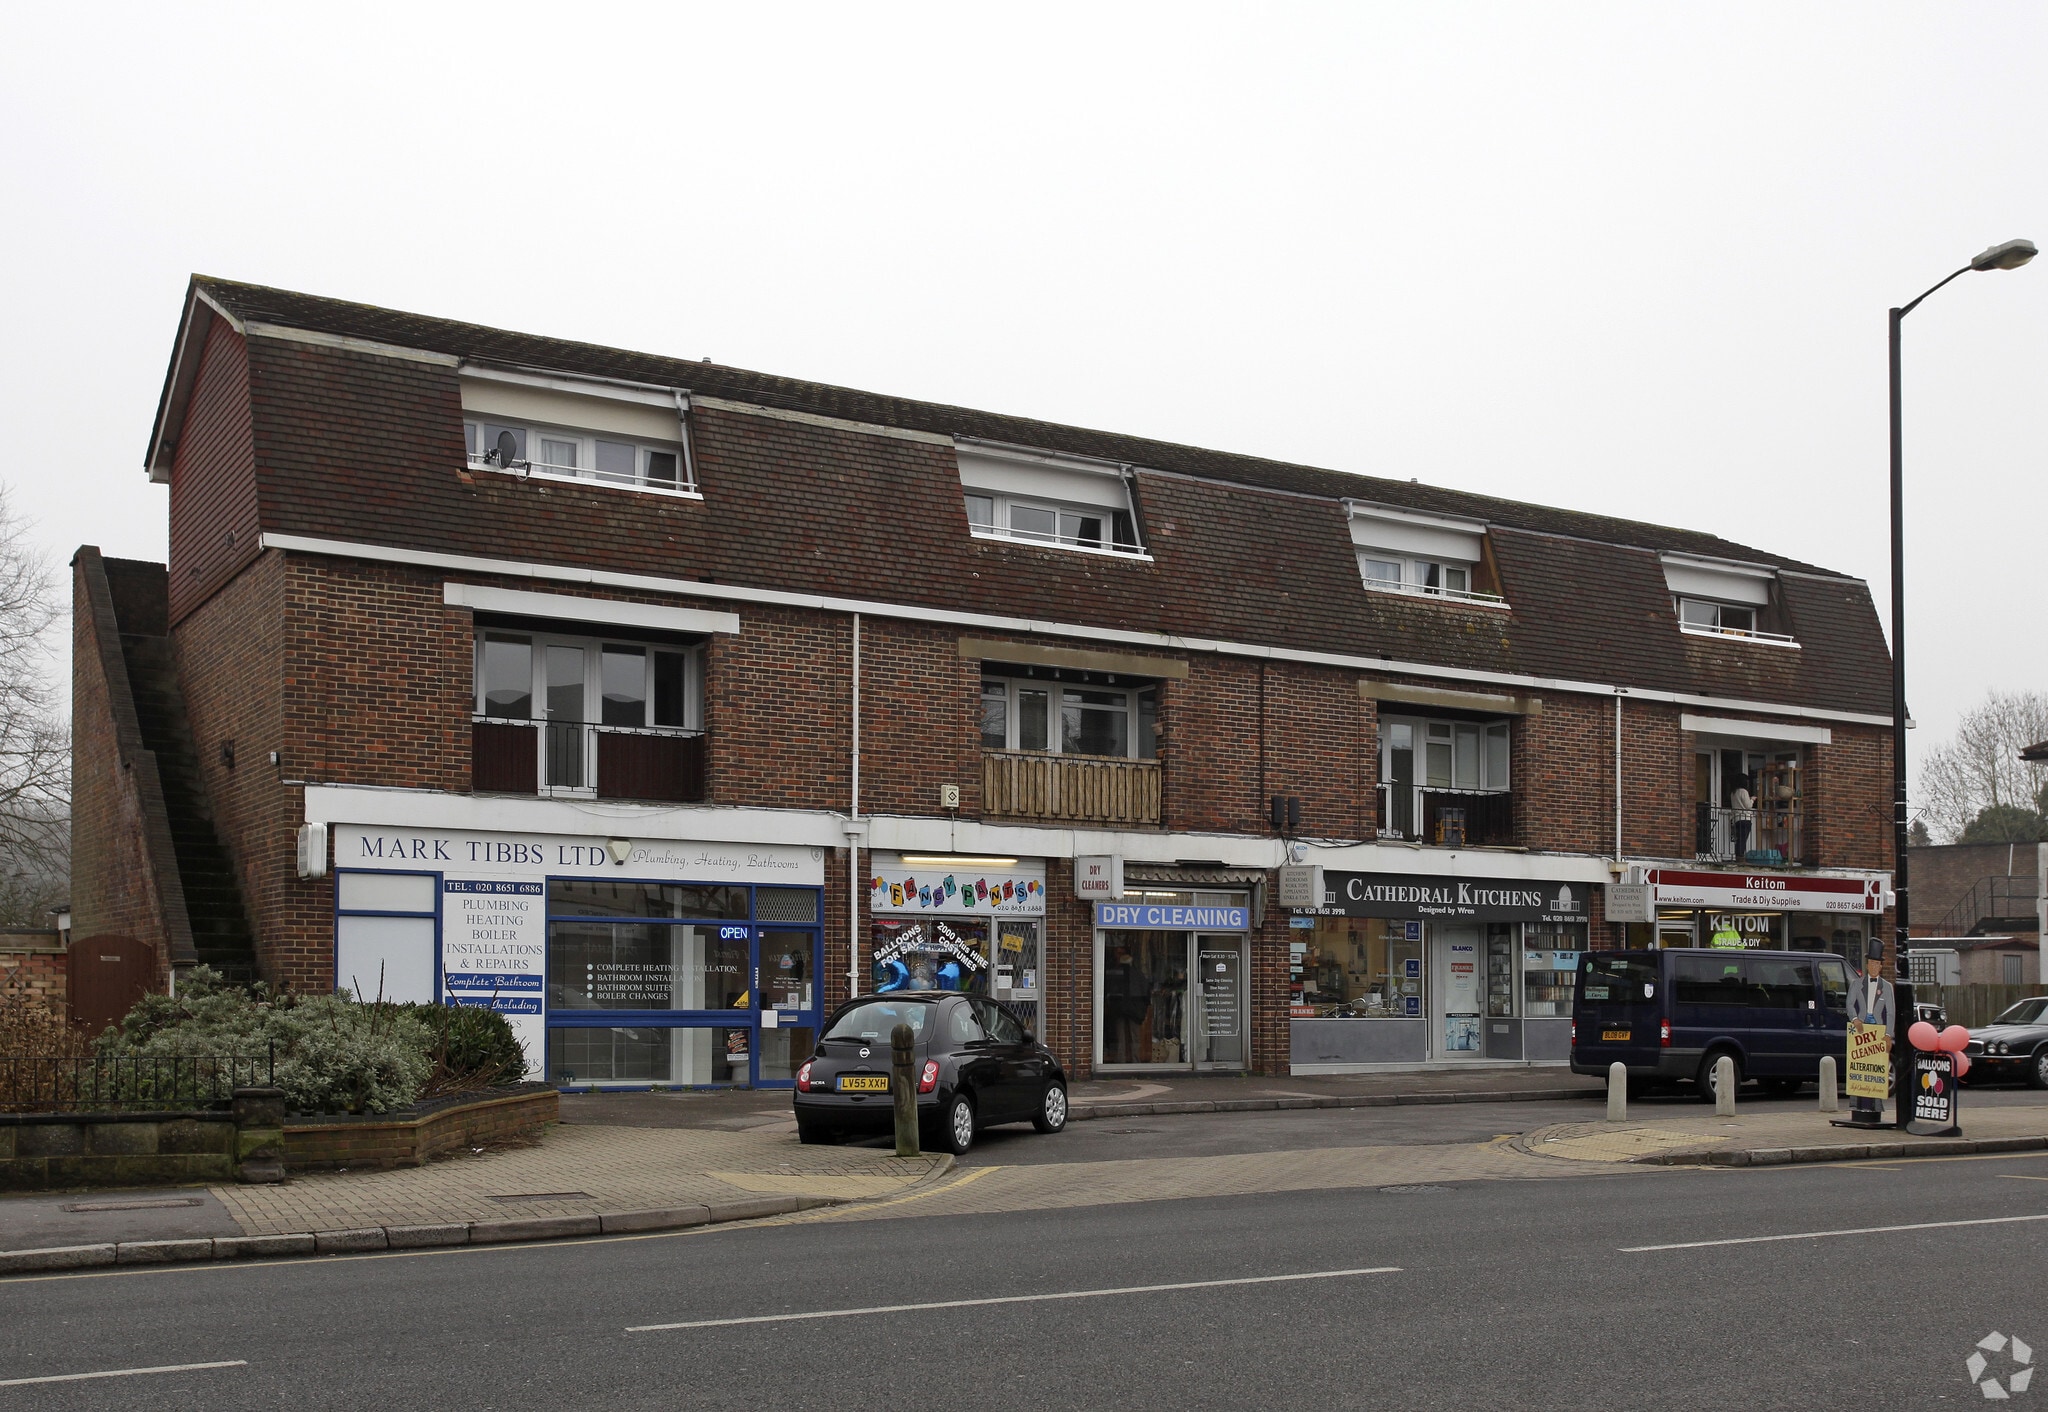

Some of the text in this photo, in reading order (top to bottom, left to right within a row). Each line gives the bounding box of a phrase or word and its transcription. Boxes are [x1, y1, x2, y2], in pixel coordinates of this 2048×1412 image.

[361, 836, 606, 866] MARK TIBBS LTD
[633, 848, 799, 871] Plumbing, Heating, Bathrooms
[1089, 865, 1101, 875] DRY
[447, 882, 541, 893] TEL: 020 8651 6886
[1081, 880, 1109, 890] CLEANERS
[1746, 877, 1786, 890] Keitom
[892, 878, 1027, 904] FANCY PANTS
[1346, 878, 1542, 907] CATHEDRAL KITCHENS
[463, 899, 529, 912] PLUMBING
[1658, 895, 1705, 904] www.keitom.com
[1731, 895, 1752, 904] Trade
[1752, 896, 1758, 904] &
[1758, 896, 1770, 906] Diy
[1770, 897, 1801, 907] Supplies
[1851, 902, 1865, 910] 6499
[1103, 907, 1242, 926] DRY CLEANING
[1418, 905, 1447, 915] Designed
[1447, 906, 1456, 915] by
[466, 914, 524, 926] HEATING
[1710, 915, 1769, 933] KEITOM
[472, 929, 517, 940] BOILER
[720, 927, 748, 939] OPEN
[446, 943, 543, 955] INSTALLATIONS
[873, 924, 922, 961] BALLOONS
[936, 921, 989, 969] 2000 Plus HIRE
[1717, 938, 1761, 947] TRADE & DIY
[880, 934, 925, 968] FOR SALE
[938, 936, 978, 972] COSTUMES
[460, 958, 529, 970] & REPAIRS
[596, 963, 640, 972] COMPLETE
[642, 964, 680, 972] HEATING
[447, 975, 540, 989] Complete Bathroom
[645, 984, 673, 992] SUITES
[596, 992, 627, 1000] BOILER
[491, 999, 538, 1014] Including
[1854, 1030, 1878, 1046] DRY
[1851, 1042, 1886, 1060] CLEANING
[1849, 1061, 1886, 1073] ALTERATIONS
[1917, 1059, 1951, 1072] BALLOONS
[842, 1078, 886, 1088] LV55 XXH
[1849, 1073, 1886, 1084] SHOE REPAIRS
[1916, 1095, 1948, 1108] SOLD
[1915, 1106, 1948, 1120] HERE
